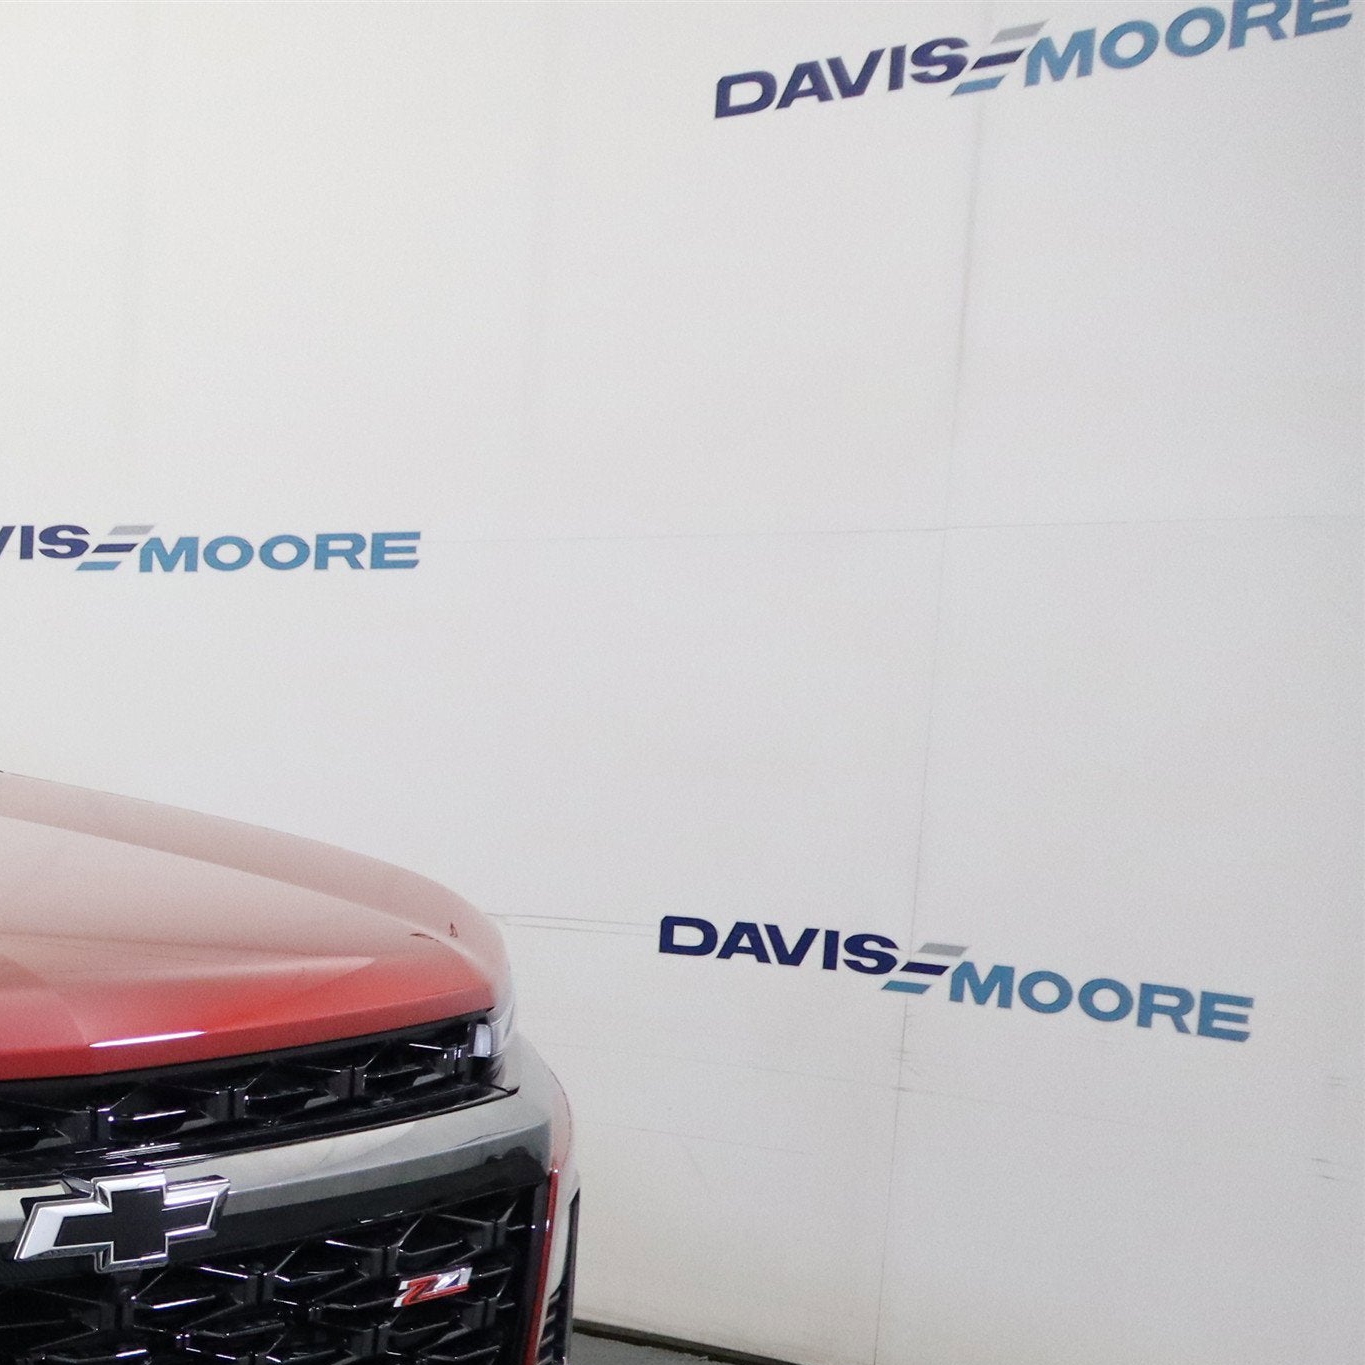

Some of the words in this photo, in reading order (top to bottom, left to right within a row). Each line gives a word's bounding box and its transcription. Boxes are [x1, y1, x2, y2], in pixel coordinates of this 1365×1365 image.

[714, 36, 968, 118] DAVIS
[1023, 0, 1354, 87] MOORE
[137, 529, 424, 574] MOORE
[659, 915, 898, 975] DAVIS
[949, 960, 1255, 1042] MOORE
